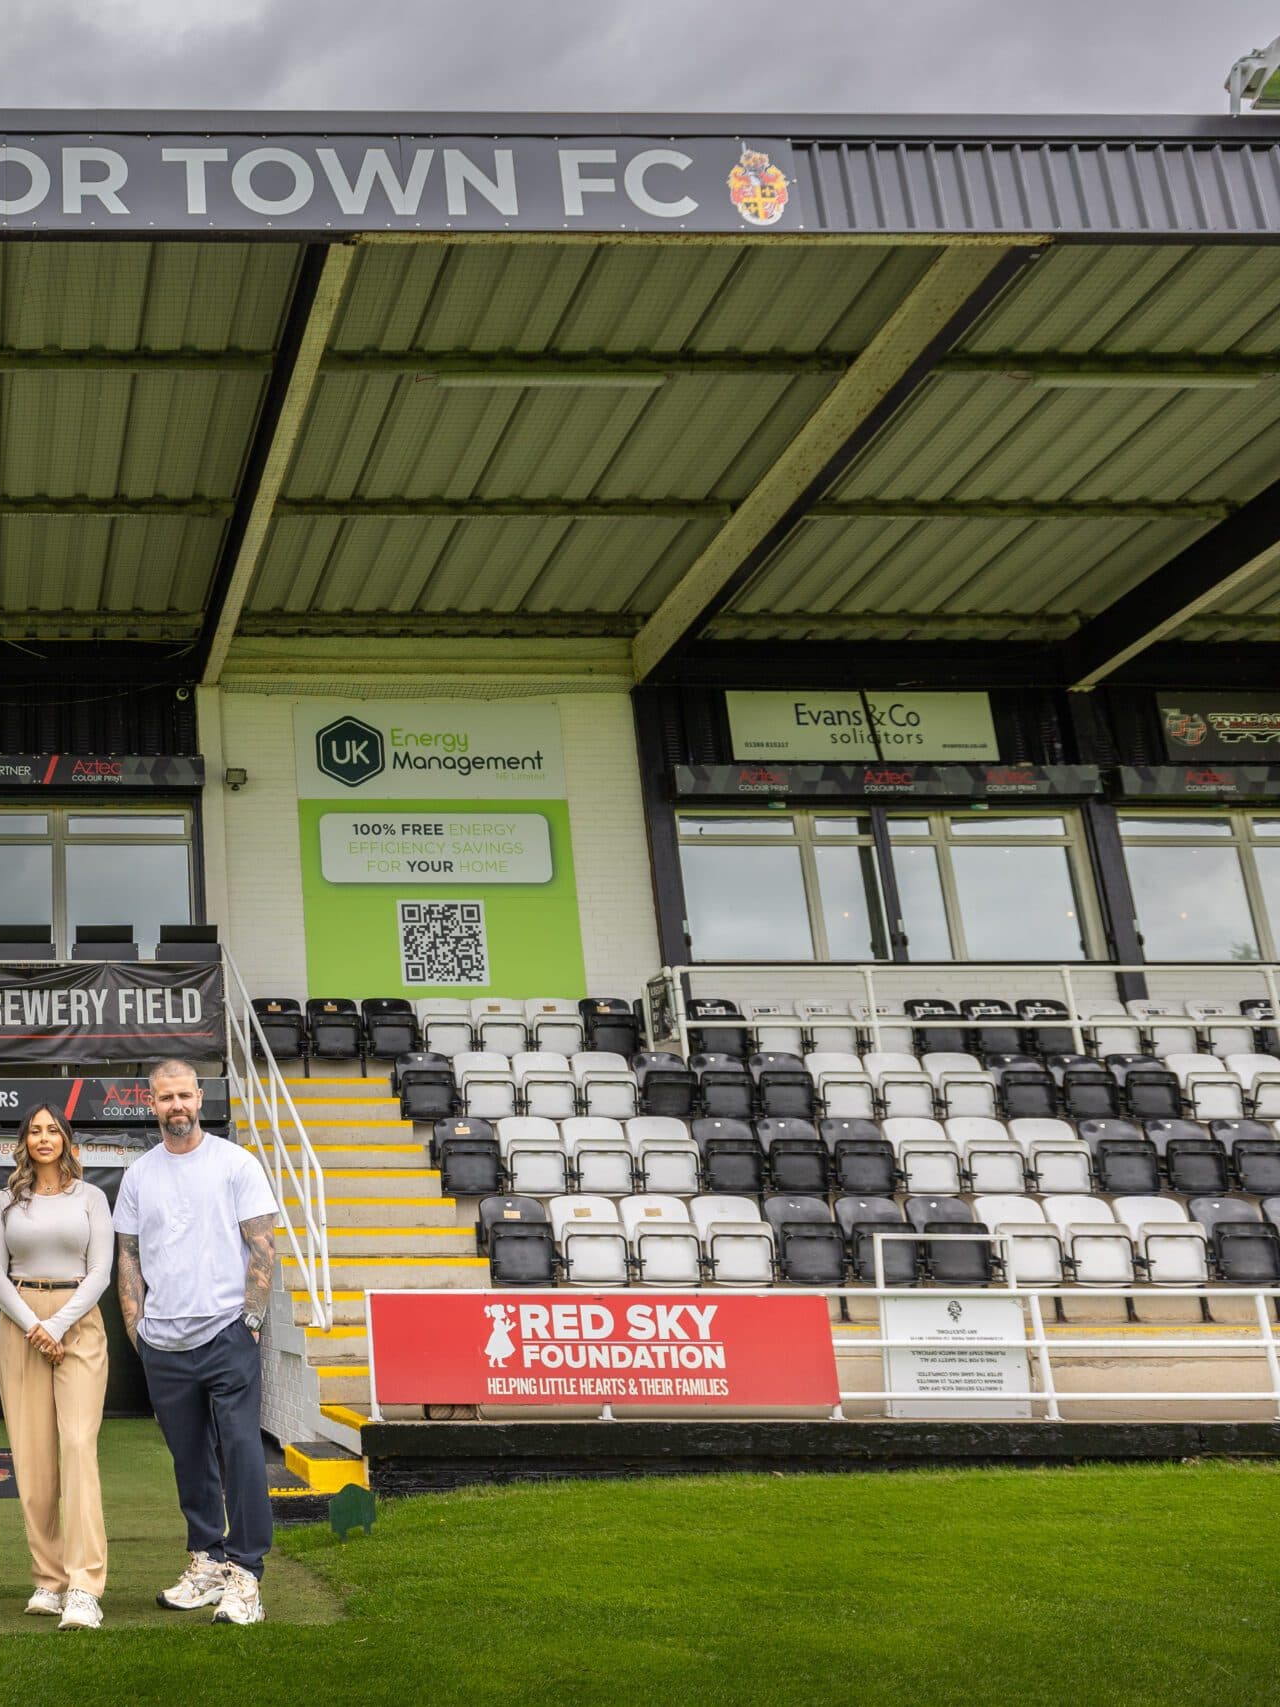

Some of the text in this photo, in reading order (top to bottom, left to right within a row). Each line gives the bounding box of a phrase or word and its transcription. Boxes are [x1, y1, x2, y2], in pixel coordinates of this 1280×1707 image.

[161, 147, 519, 216] TOWN
[558, 148, 699, 217] FC
[390, 728, 468, 751] Energy
[331, 740, 370, 765] UK
[392, 750, 543, 776] Management
[73, 760, 121, 775] Aztec
[864, 770, 913, 784] Aztec
[352, 823, 516, 836] 100% FREE ENERGY
[348, 842, 524, 855] EFFICIENCY SAVINGS
[367, 860, 509, 872] FOR YOUR HOME
[118, 987, 202, 1025] FIELD
[103, 1082, 151, 1106] Azte
[103, 1107, 144, 1116] COLOUR
[520, 1304, 719, 1340] RED SKY
[522, 1345, 726, 1369] FOUNDATION
[488, 1378, 729, 1395] HELPING LITTLE HEARTS & THEIR FAMILIES
